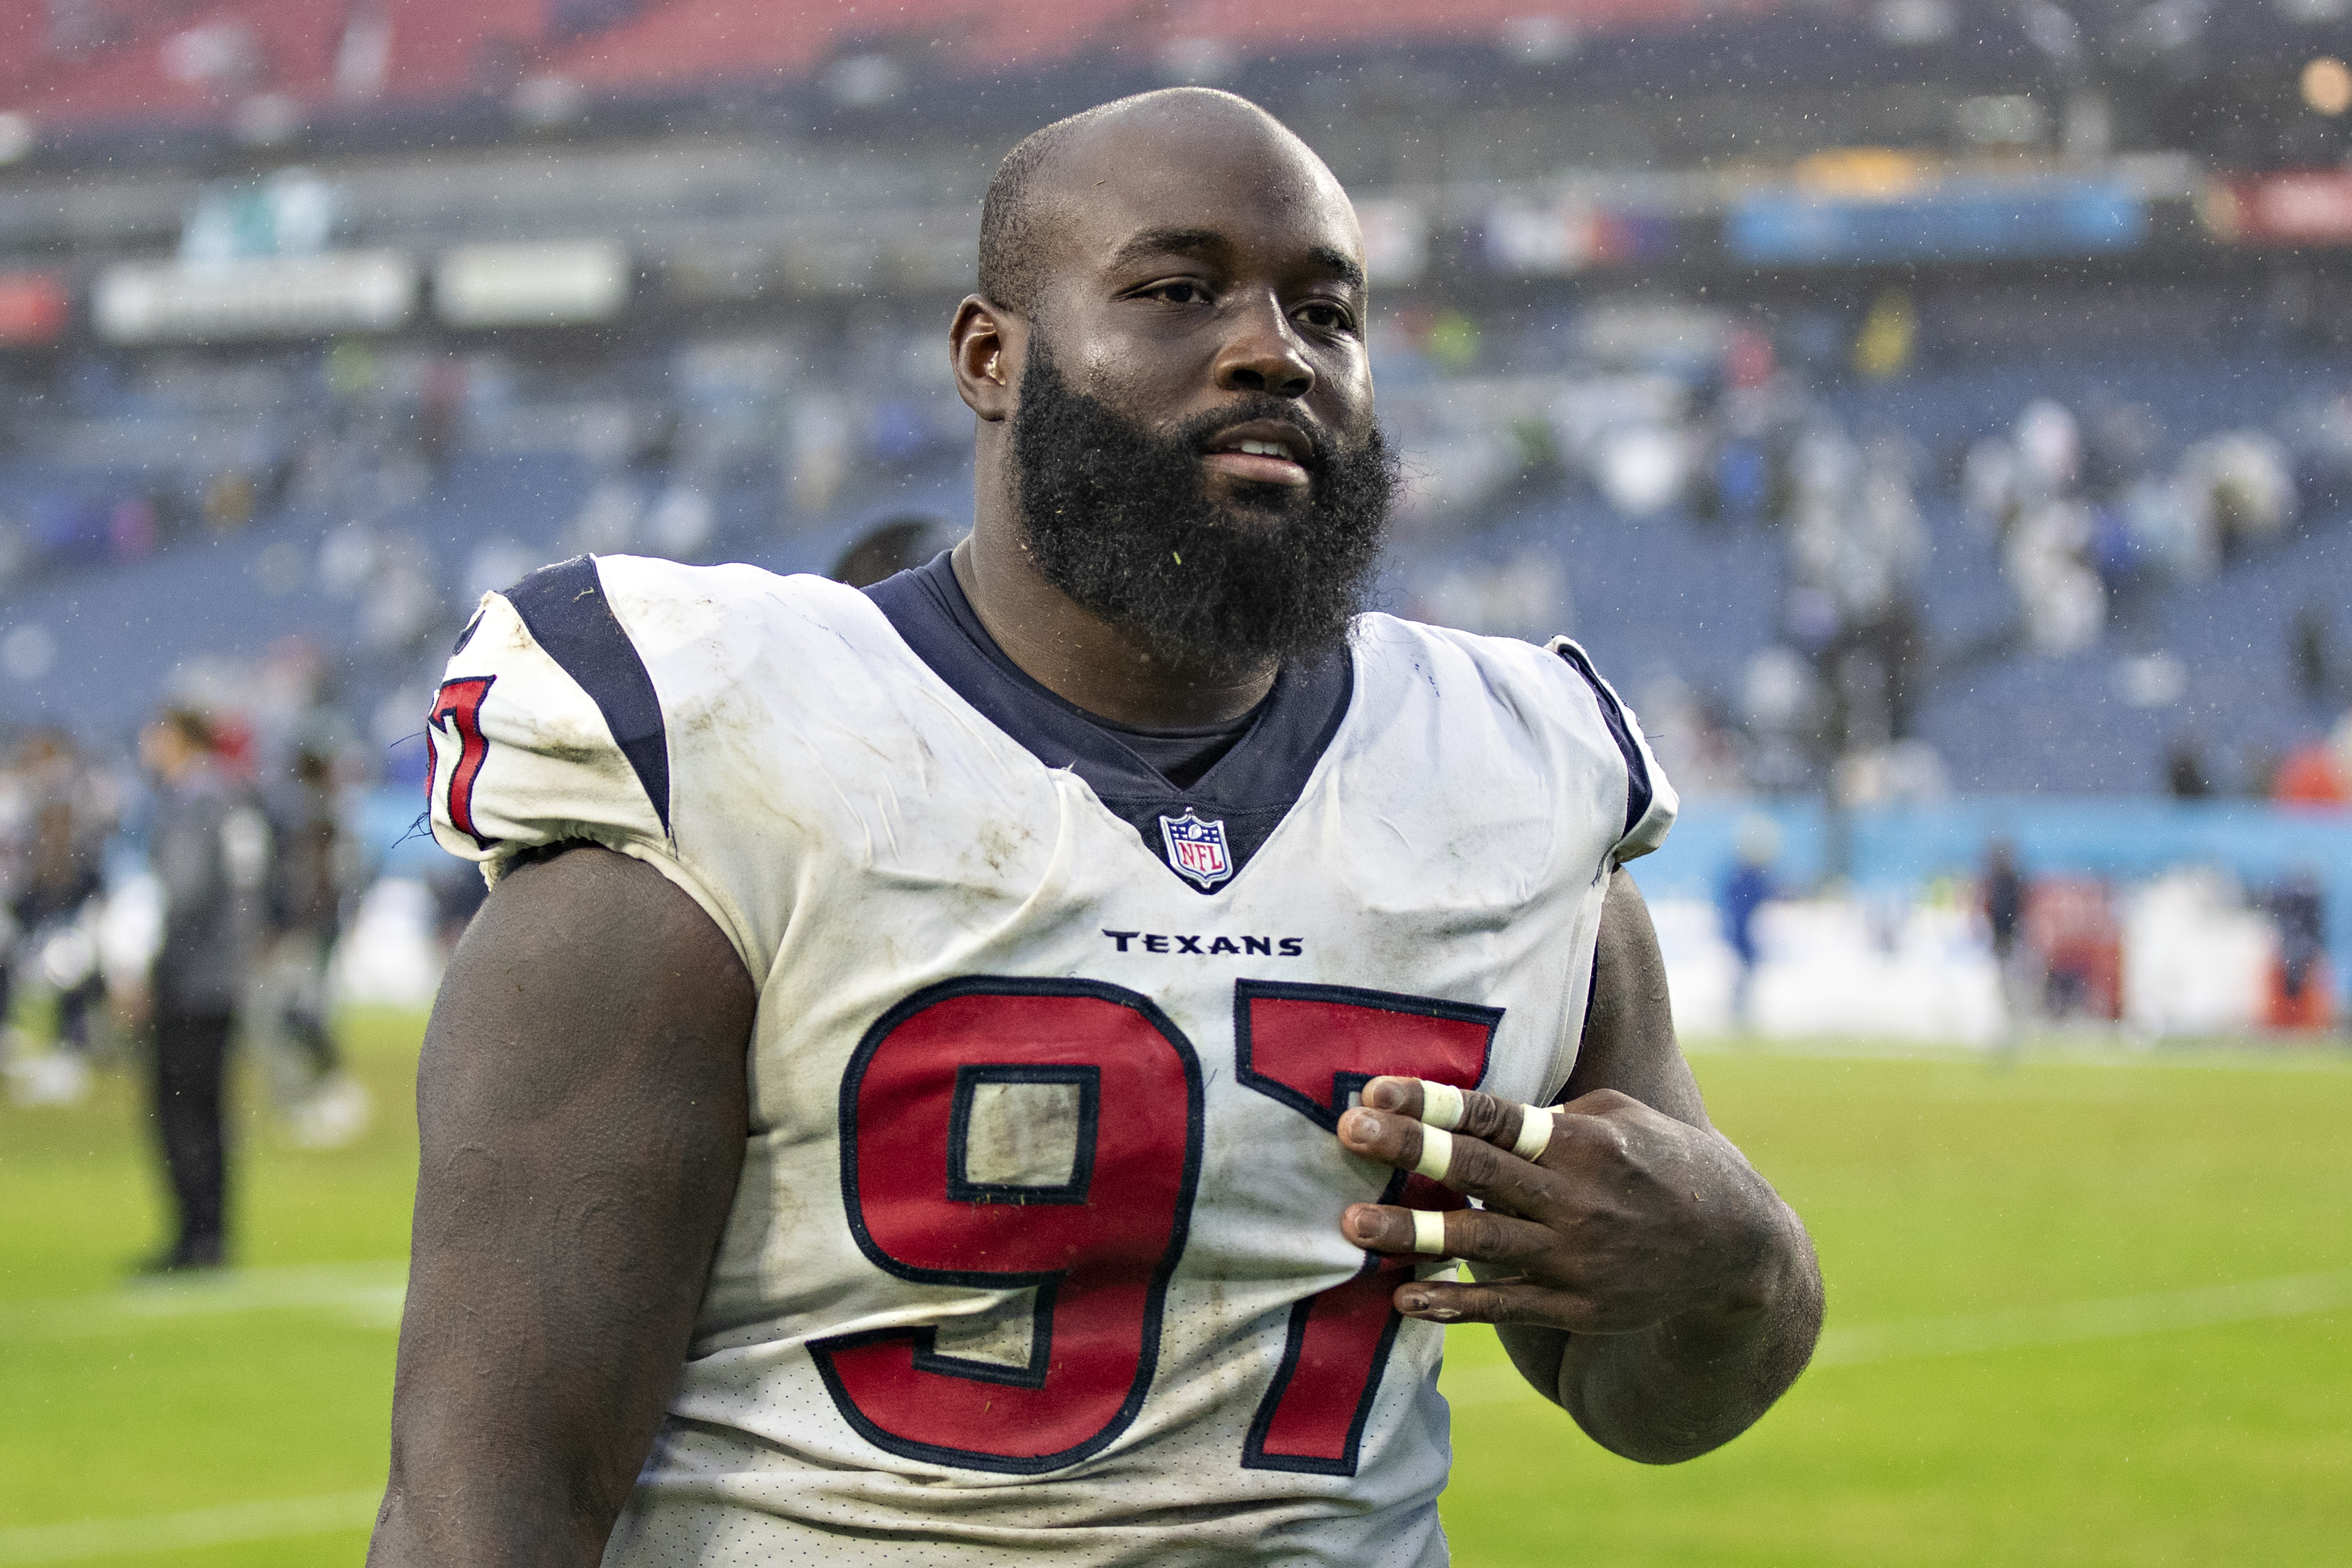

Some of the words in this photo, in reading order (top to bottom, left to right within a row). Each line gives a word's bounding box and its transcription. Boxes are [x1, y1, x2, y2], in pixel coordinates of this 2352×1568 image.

[425, 674, 502, 851] 7
[1178, 841, 1223, 873] NFL
[1101, 928, 1304, 956] TEXANS
[804, 974, 1506, 1477] 97
